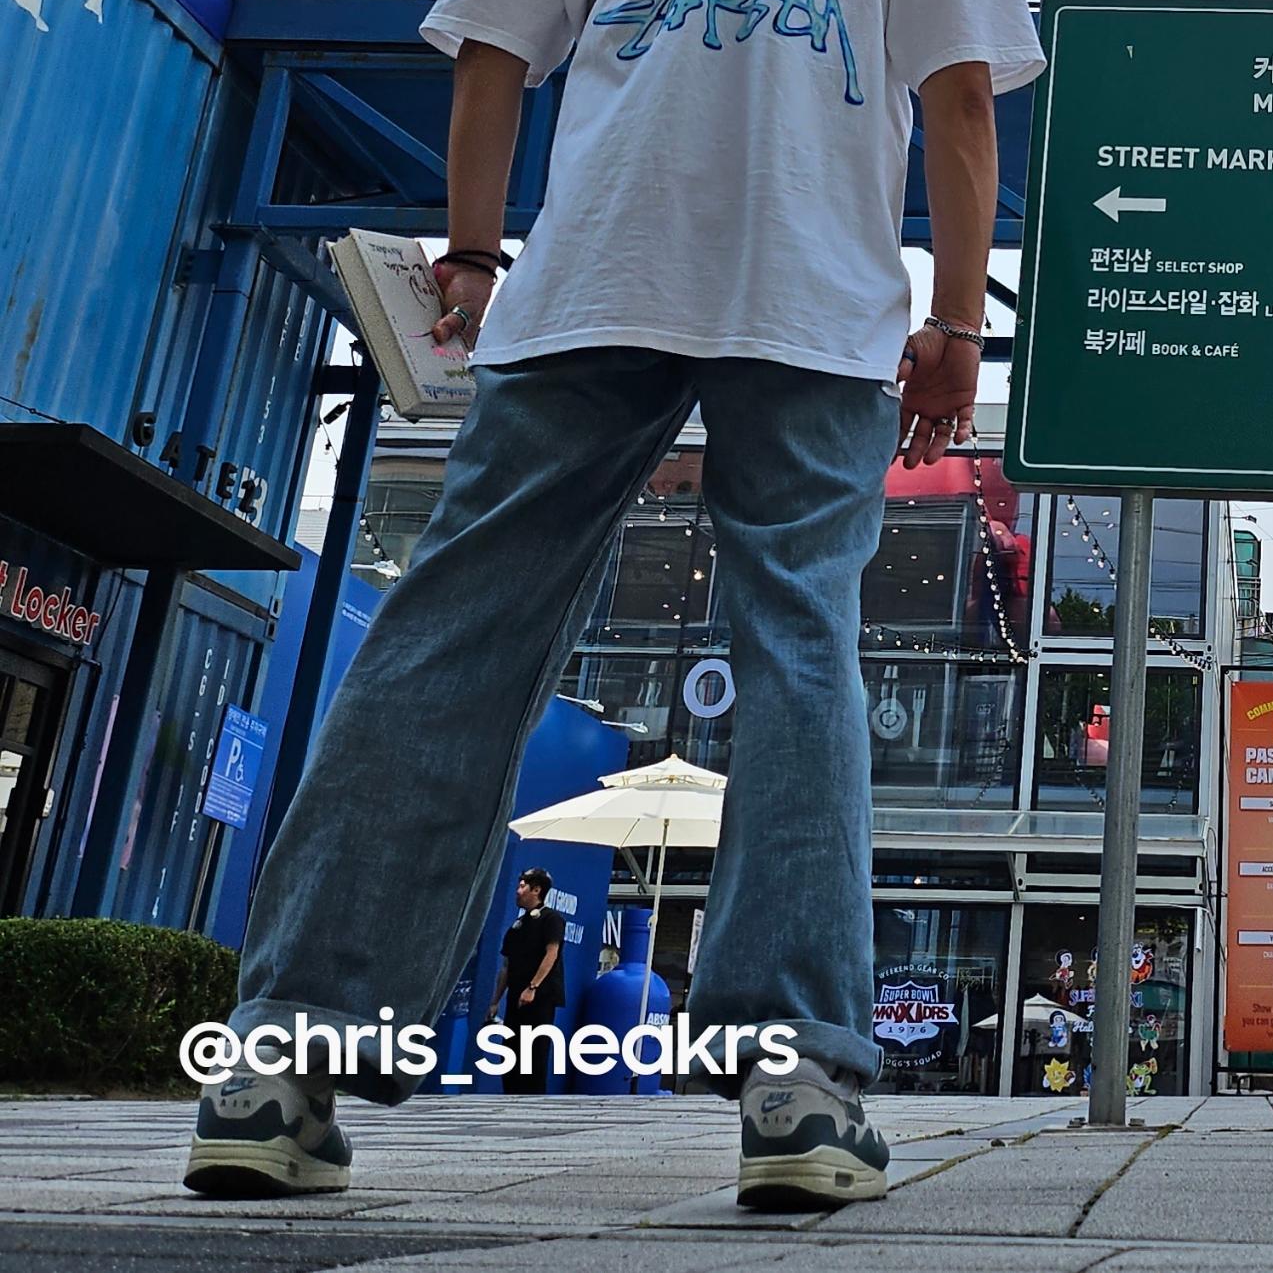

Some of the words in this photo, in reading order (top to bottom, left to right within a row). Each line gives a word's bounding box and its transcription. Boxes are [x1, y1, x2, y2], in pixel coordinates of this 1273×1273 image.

[1097, 145, 1200, 169] STREET
[1090, 247, 1151, 273] 편집샵
[1156, 261, 1205, 274] SELECT
[1208, 262, 1244, 274] SHOP
[1083, 328, 1146, 356] 북카페
[1152, 343, 1189, 356] BOOK
[1191, 345, 1202, 356] &
[1204, 343, 1240, 358] CAFÉ
[132, 411, 238, 500] GATE
[10, 566, 101, 645] Locker
[225, 736, 242, 778] P
[878, 964, 914, 979] WEEKEND
[916, 964, 938, 974] GEAR
[884, 989, 910, 1003] SUPER
[910, 989, 936, 1003] BOWL
[887, 1026, 927, 1034] 1976
[914, 1049, 942, 1067] SQUAD
